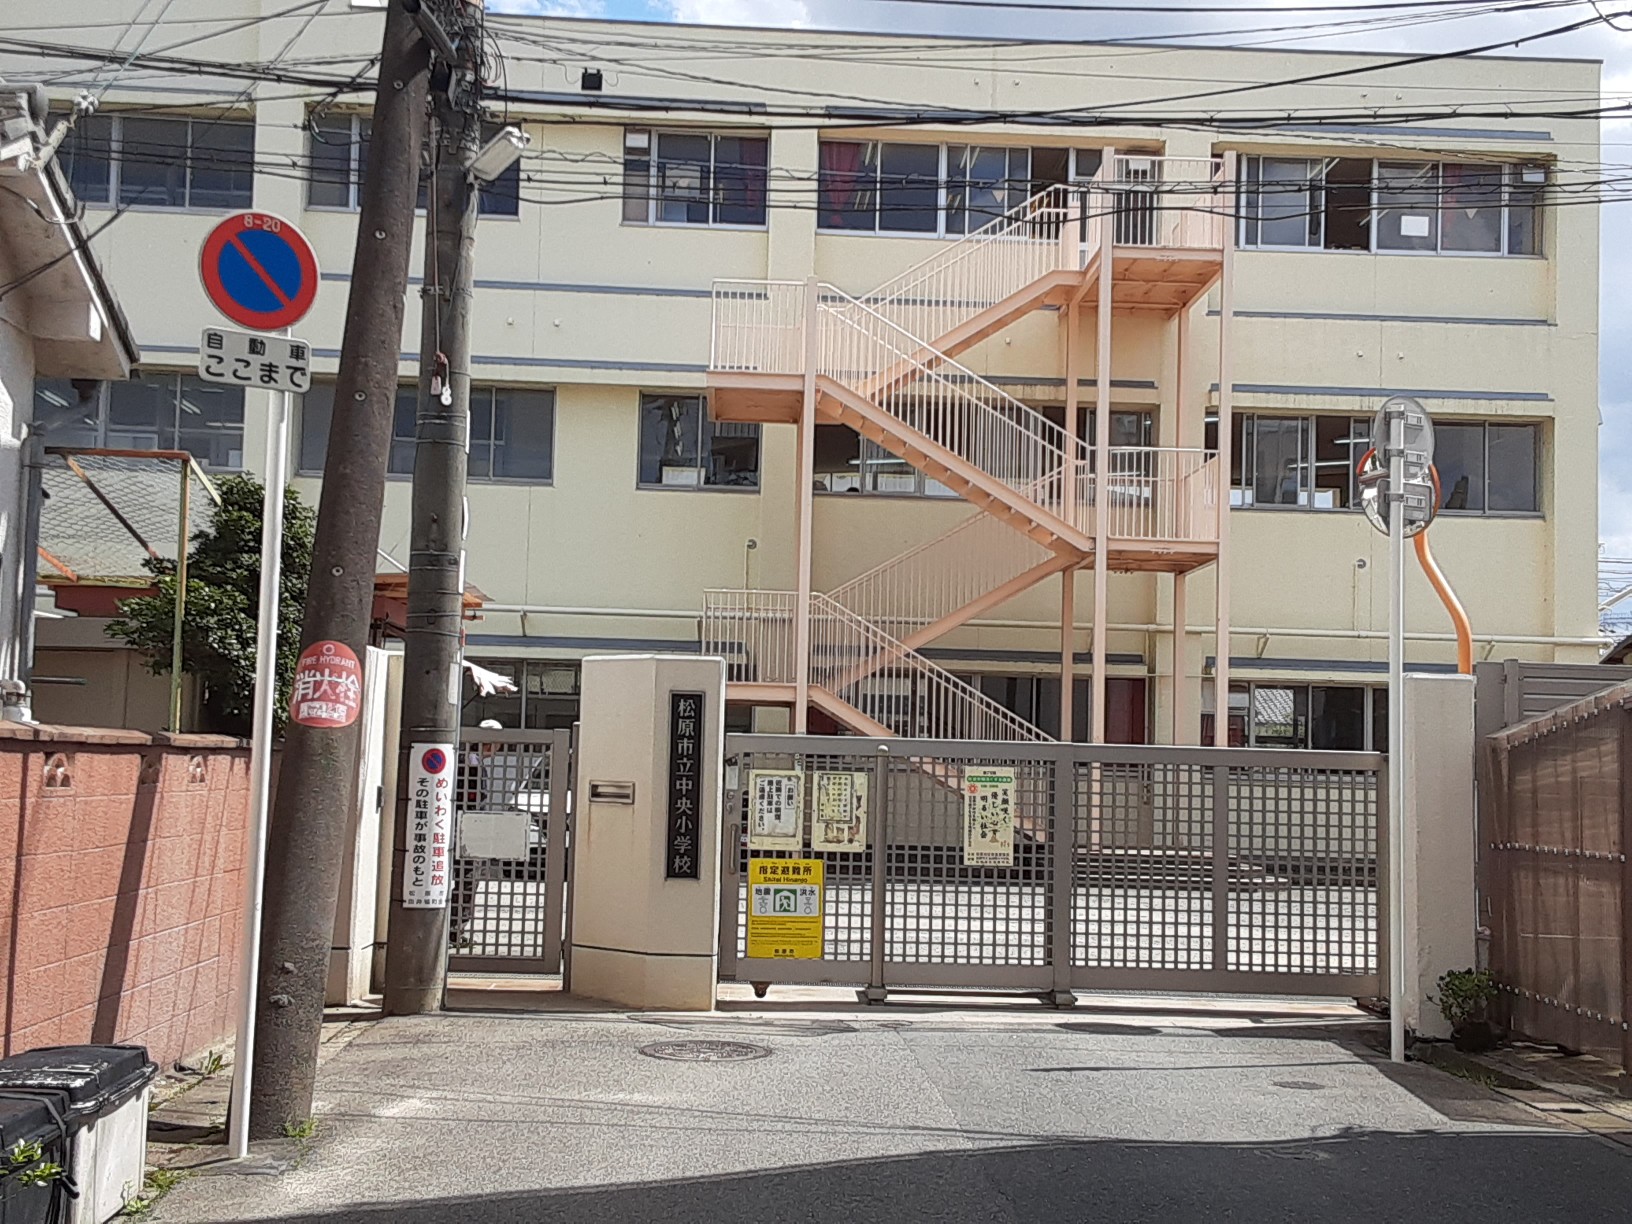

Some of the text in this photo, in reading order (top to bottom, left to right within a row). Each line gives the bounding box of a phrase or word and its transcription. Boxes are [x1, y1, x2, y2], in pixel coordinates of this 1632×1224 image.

[243, 214, 281, 233] 8-20
[206, 332, 306, 362] 自動車
[205, 354, 308, 389] ここまで
[302, 655, 356, 669] FIRE HYDRANT
[292, 668, 360, 708] 消火栓
[673, 698, 696, 874] 松原市立中央小学校
[412, 777, 429, 887] その駐車が事故のもと
[431, 778, 448, 886] めいわく駐車追放
[980, 795, 988, 839] 明るい社会
[759, 865, 813, 876] 指定避難所
[755, 887, 771, 896] 地震
[800, 887, 816, 897] 洪水
